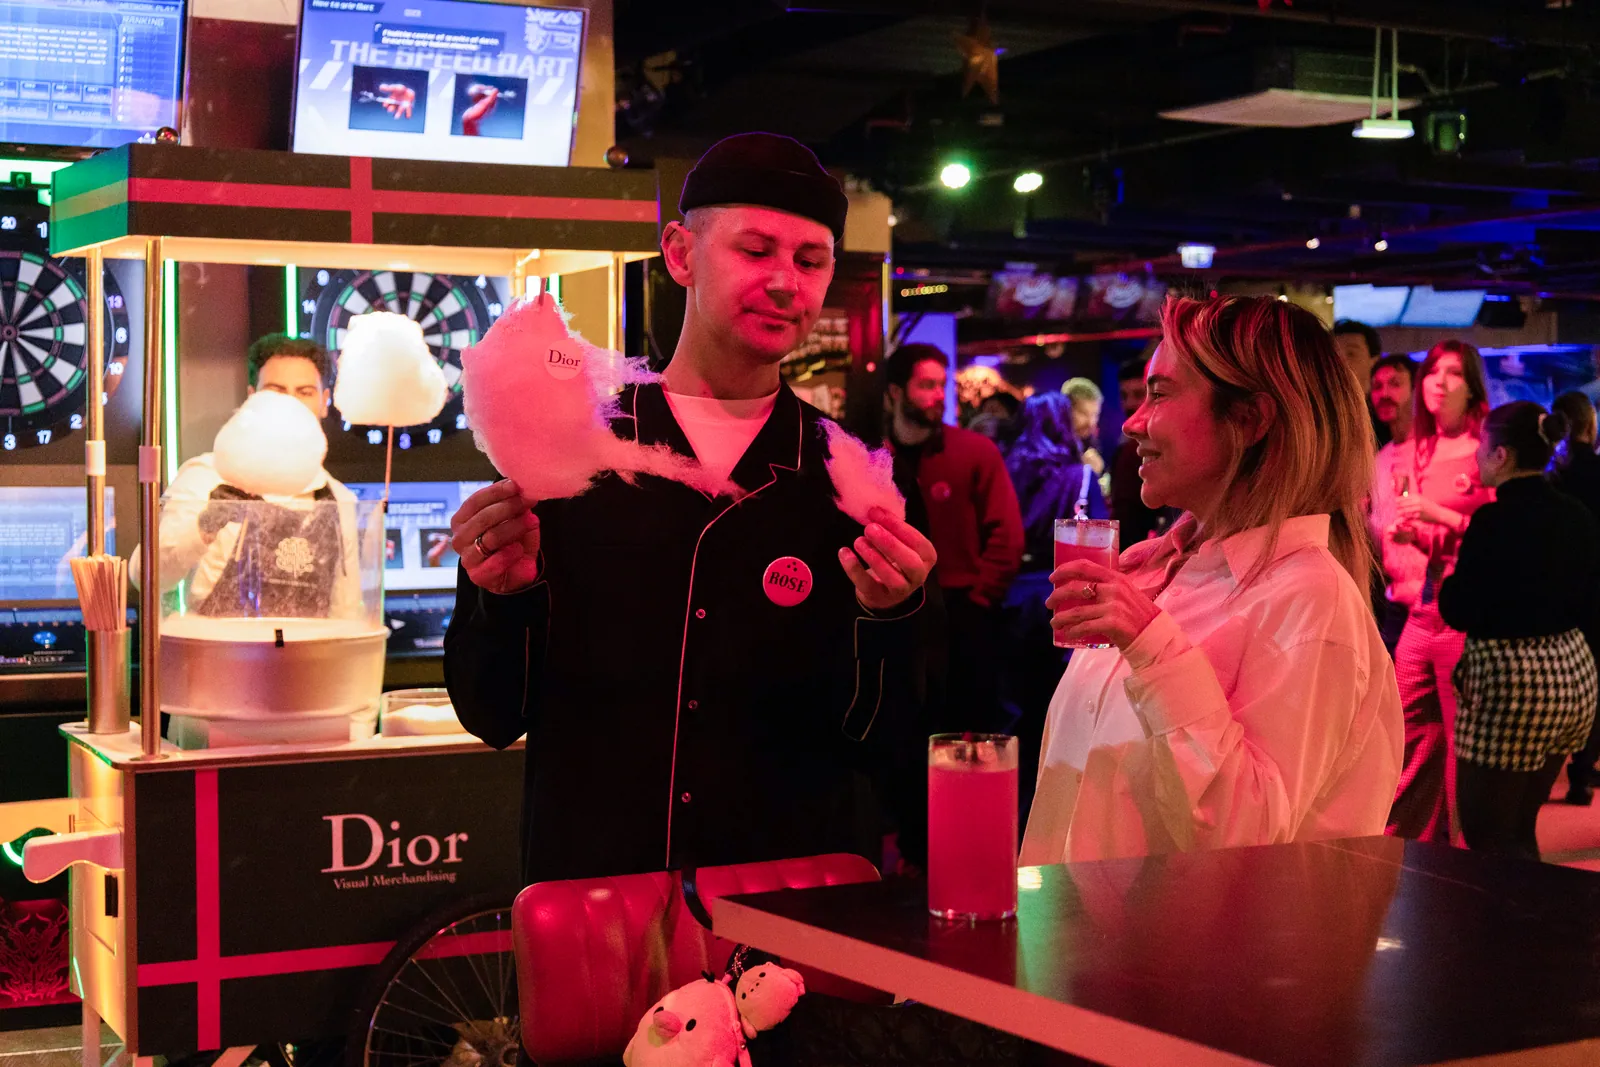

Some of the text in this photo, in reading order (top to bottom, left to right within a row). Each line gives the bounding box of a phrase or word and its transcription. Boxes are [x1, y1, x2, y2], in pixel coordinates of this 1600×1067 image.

[122, 15, 165, 27] RANKING
[330, 40, 389, 63] THE
[395, 47, 493, 73] SPEED
[497, 53, 575, 77] DART
[1, 216, 17, 230] 20
[37, 222, 48, 239] 1
[475, 274, 488, 289] 4
[108, 295, 123, 309] 13
[302, 299, 317, 315] 14
[115, 326, 127, 344] 6
[547, 348, 581, 367] Dior
[109, 361, 124, 375] 10
[70, 413, 83, 430] 2
[455, 413, 467, 430] 2
[4, 433, 16, 451] 3
[37, 429, 52, 445] 17
[398, 434, 411, 450] 3
[427, 428, 443, 444] 17
[768, 571, 808, 593] ROSE
[320, 813, 469, 873] Dior
[333, 870, 457, 890] Visual Merchandising
